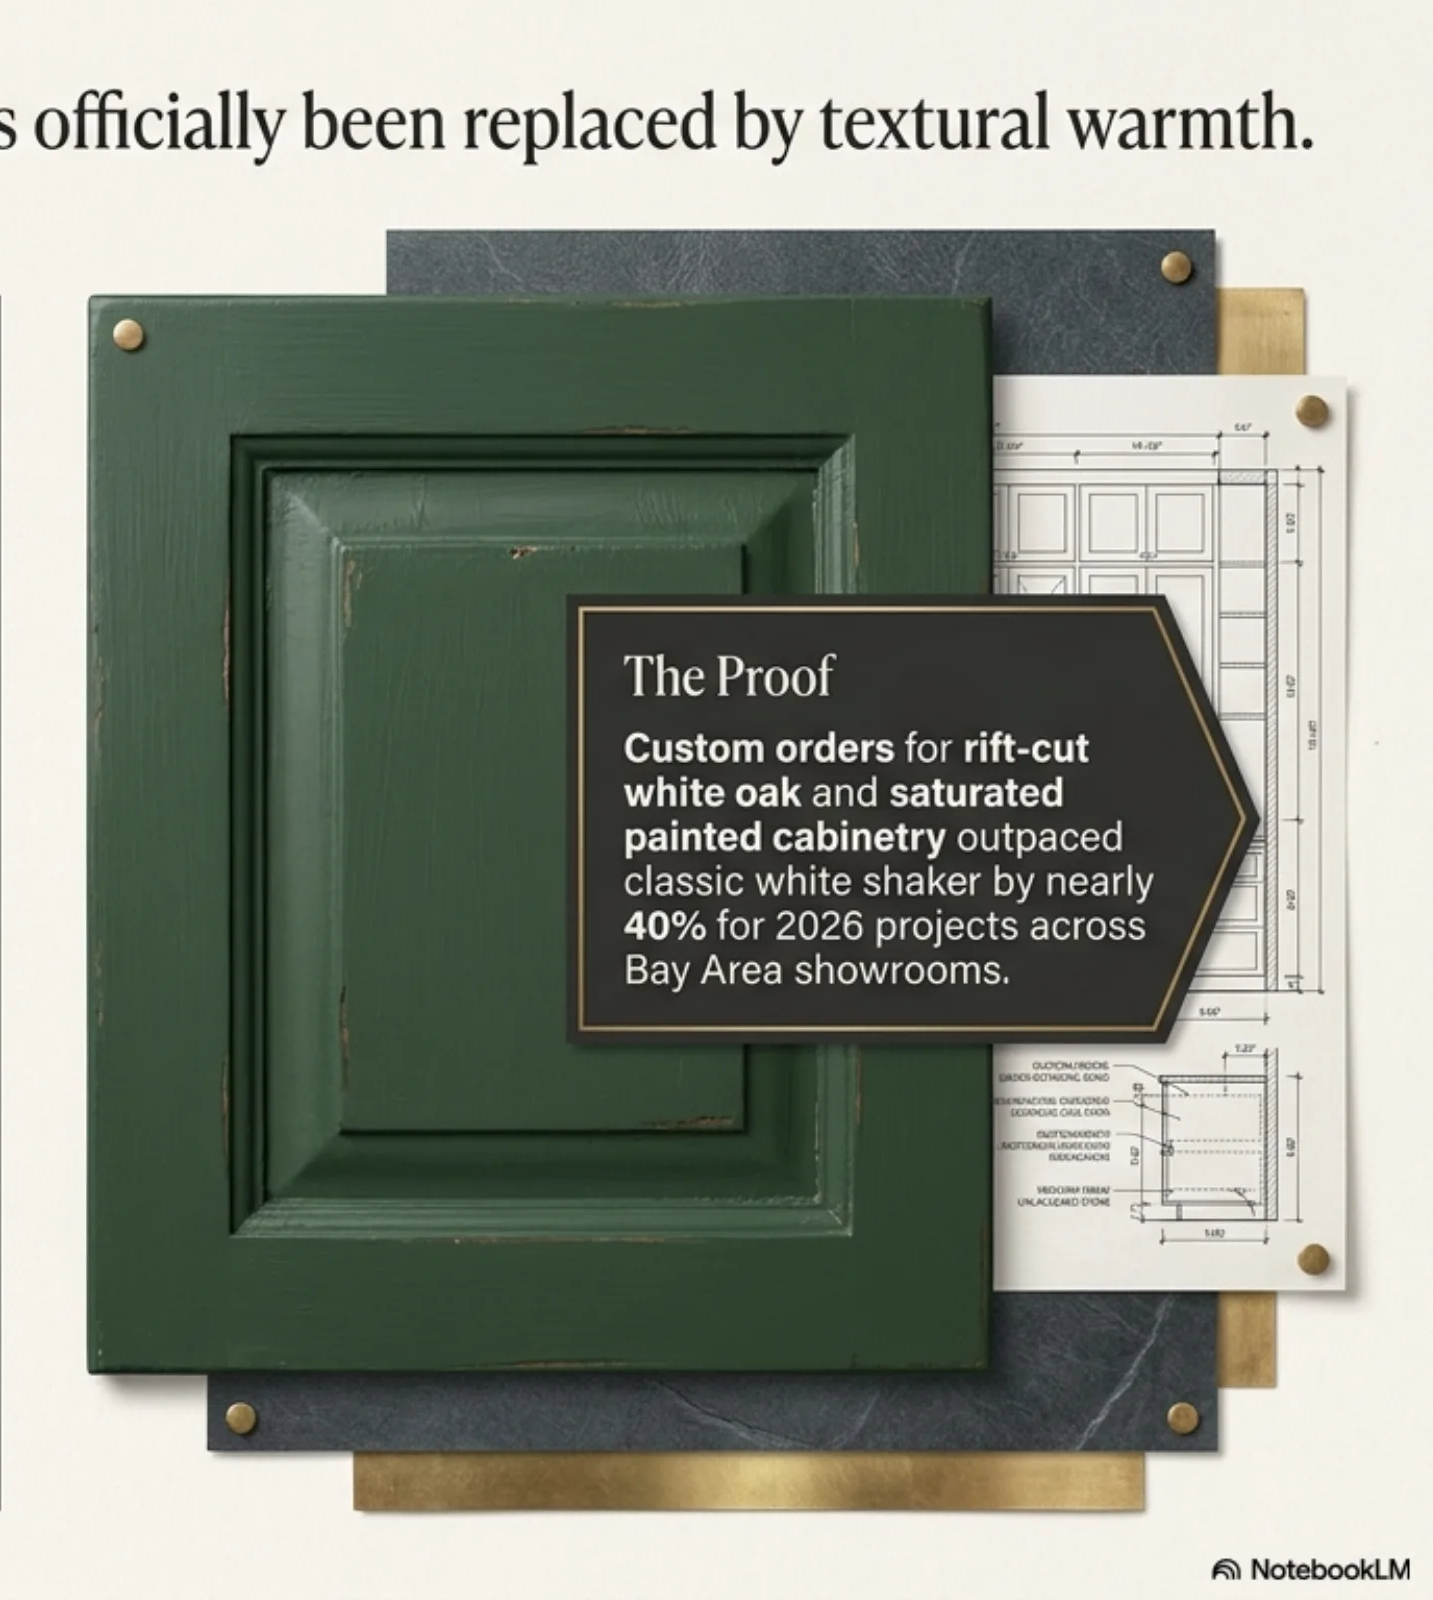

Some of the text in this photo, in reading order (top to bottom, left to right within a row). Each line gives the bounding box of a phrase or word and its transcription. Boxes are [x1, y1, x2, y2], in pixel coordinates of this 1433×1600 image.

[623, 652, 838, 697] The Proof
[624, 730, 1090, 764] Custom orders for rift-cut
[623, 775, 1064, 808] white oak and saturated
[625, 818, 1123, 861] painted cabinetry outpaced
[624, 863, 1155, 905] classic white shaker by nearly
[623, 907, 1146, 949] 40% for 2026 projects across
[625, 952, 1010, 993] Bay Area showrooms.
